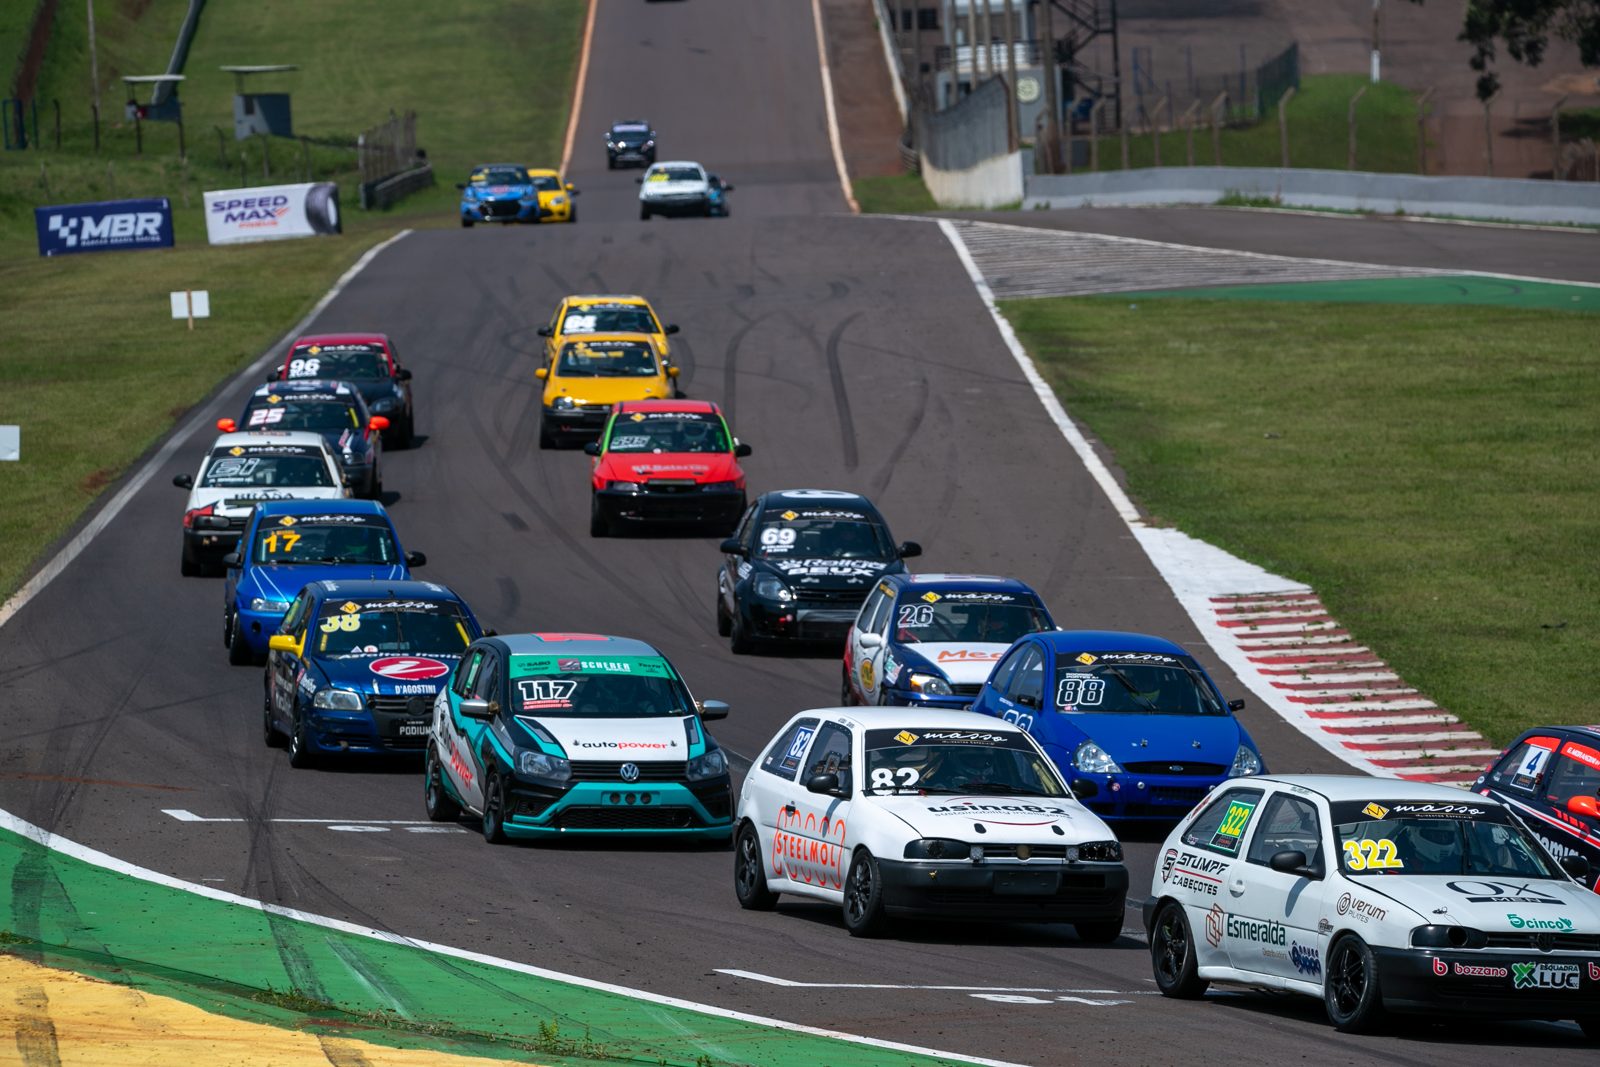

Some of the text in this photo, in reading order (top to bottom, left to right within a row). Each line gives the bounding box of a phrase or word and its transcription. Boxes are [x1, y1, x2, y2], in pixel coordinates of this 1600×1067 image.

[212, 196, 288, 213] SPEED
[80, 212, 163, 240] MBR
[224, 208, 276, 223] MAX
[290, 359, 320, 372] 96
[250, 408, 285, 425] 25
[264, 534, 301, 553] 17
[761, 527, 797, 545] 69
[898, 604, 934, 626] 26
[395, 685, 437, 694] D'AGOSTINI
[518, 680, 577, 701] 117
[1056, 679, 1105, 706] 88
[790, 731, 811, 757] 82
[922, 731, 1007, 742] masso
[1526, 750, 1543, 775] 4
[871, 767, 919, 795] 82
[927, 802, 1070, 817] usina82
[1393, 804, 1485, 815] masso
[1221, 805, 1250, 836] 322
[776, 832, 836, 867] STEELMOL
[1344, 839, 1404, 871] 322
[1176, 852, 1230, 875] STUMPF
[1172, 875, 1218, 896] CABEÇOTES
[1348, 910, 1369, 923] PILATES
[1352, 898, 1386, 921] verum
[1227, 913, 1286, 946] Esmeralda
[1455, 963, 1507, 977] bozzano
[1539, 972, 1579, 987] LUC
